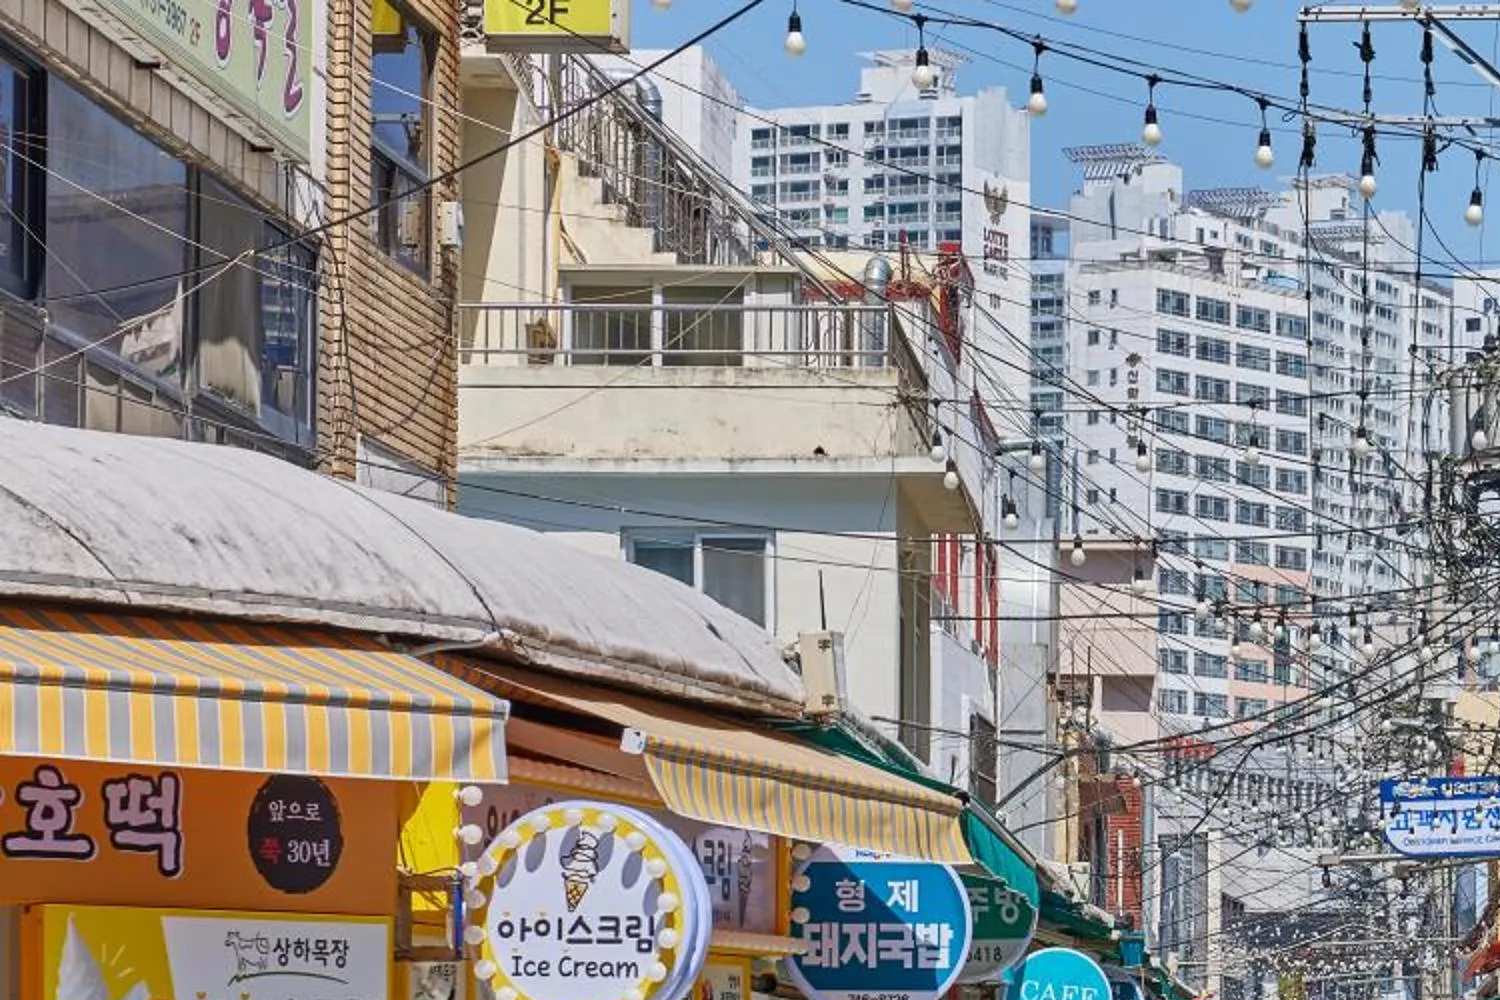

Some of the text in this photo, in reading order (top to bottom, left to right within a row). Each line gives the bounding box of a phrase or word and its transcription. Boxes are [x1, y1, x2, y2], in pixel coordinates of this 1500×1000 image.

[0, 764, 184, 879] 호떡
[268, 801, 322, 821] 앞으로
[287, 840, 331, 867] 30년
[497, 914, 656, 953] 아이스크림
[801, 922, 954, 969] 돼지국밥
[271, 938, 350, 968] 상하목장
[511, 955, 640, 979] Ice Cream
